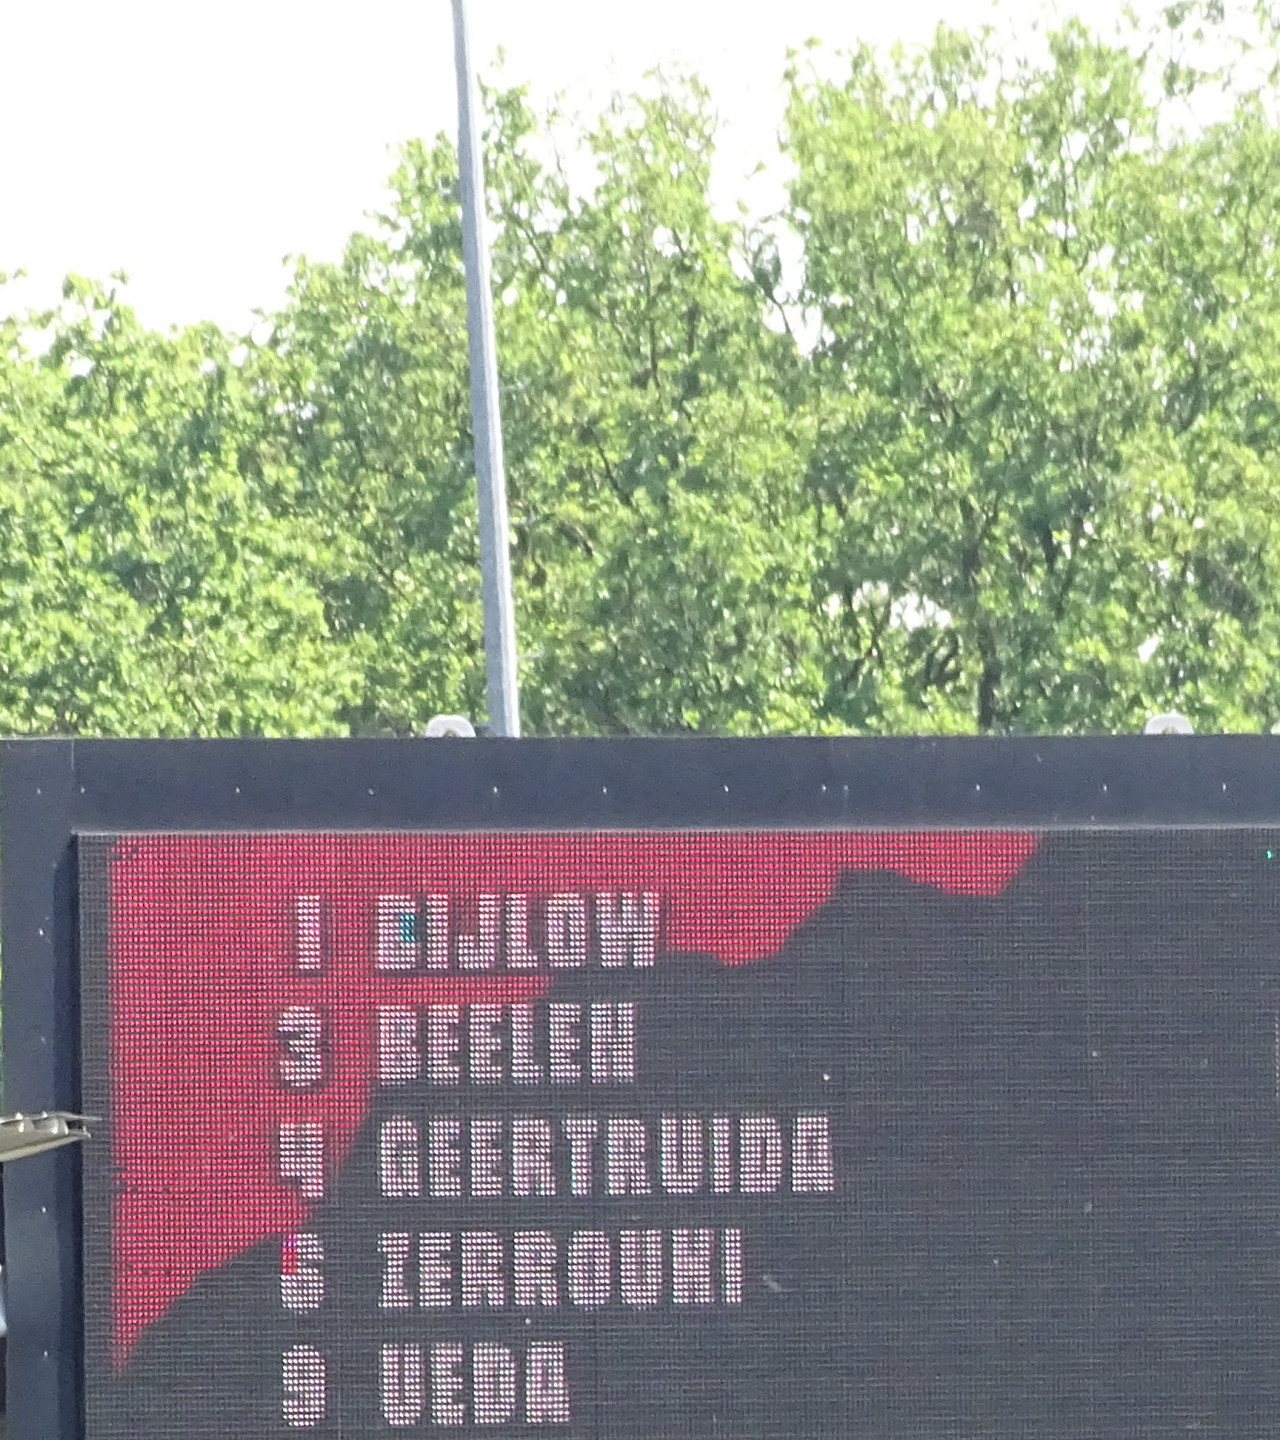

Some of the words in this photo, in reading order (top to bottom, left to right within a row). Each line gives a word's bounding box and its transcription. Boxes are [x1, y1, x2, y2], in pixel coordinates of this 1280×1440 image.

[297, 895, 321, 970] 1
[377, 892, 659, 970] BIJLOW
[278, 1005, 322, 1087] 3
[379, 1002, 634, 1085] BEELEN
[279, 1122, 324, 1197] 4
[380, 1113, 834, 1197] GEERTRUIDA
[280, 1233, 324, 1309] 6
[377, 1228, 742, 1308] ZERROUKI
[282, 1344, 326, 1427] 9
[382, 1341, 570, 1425] UEDA
